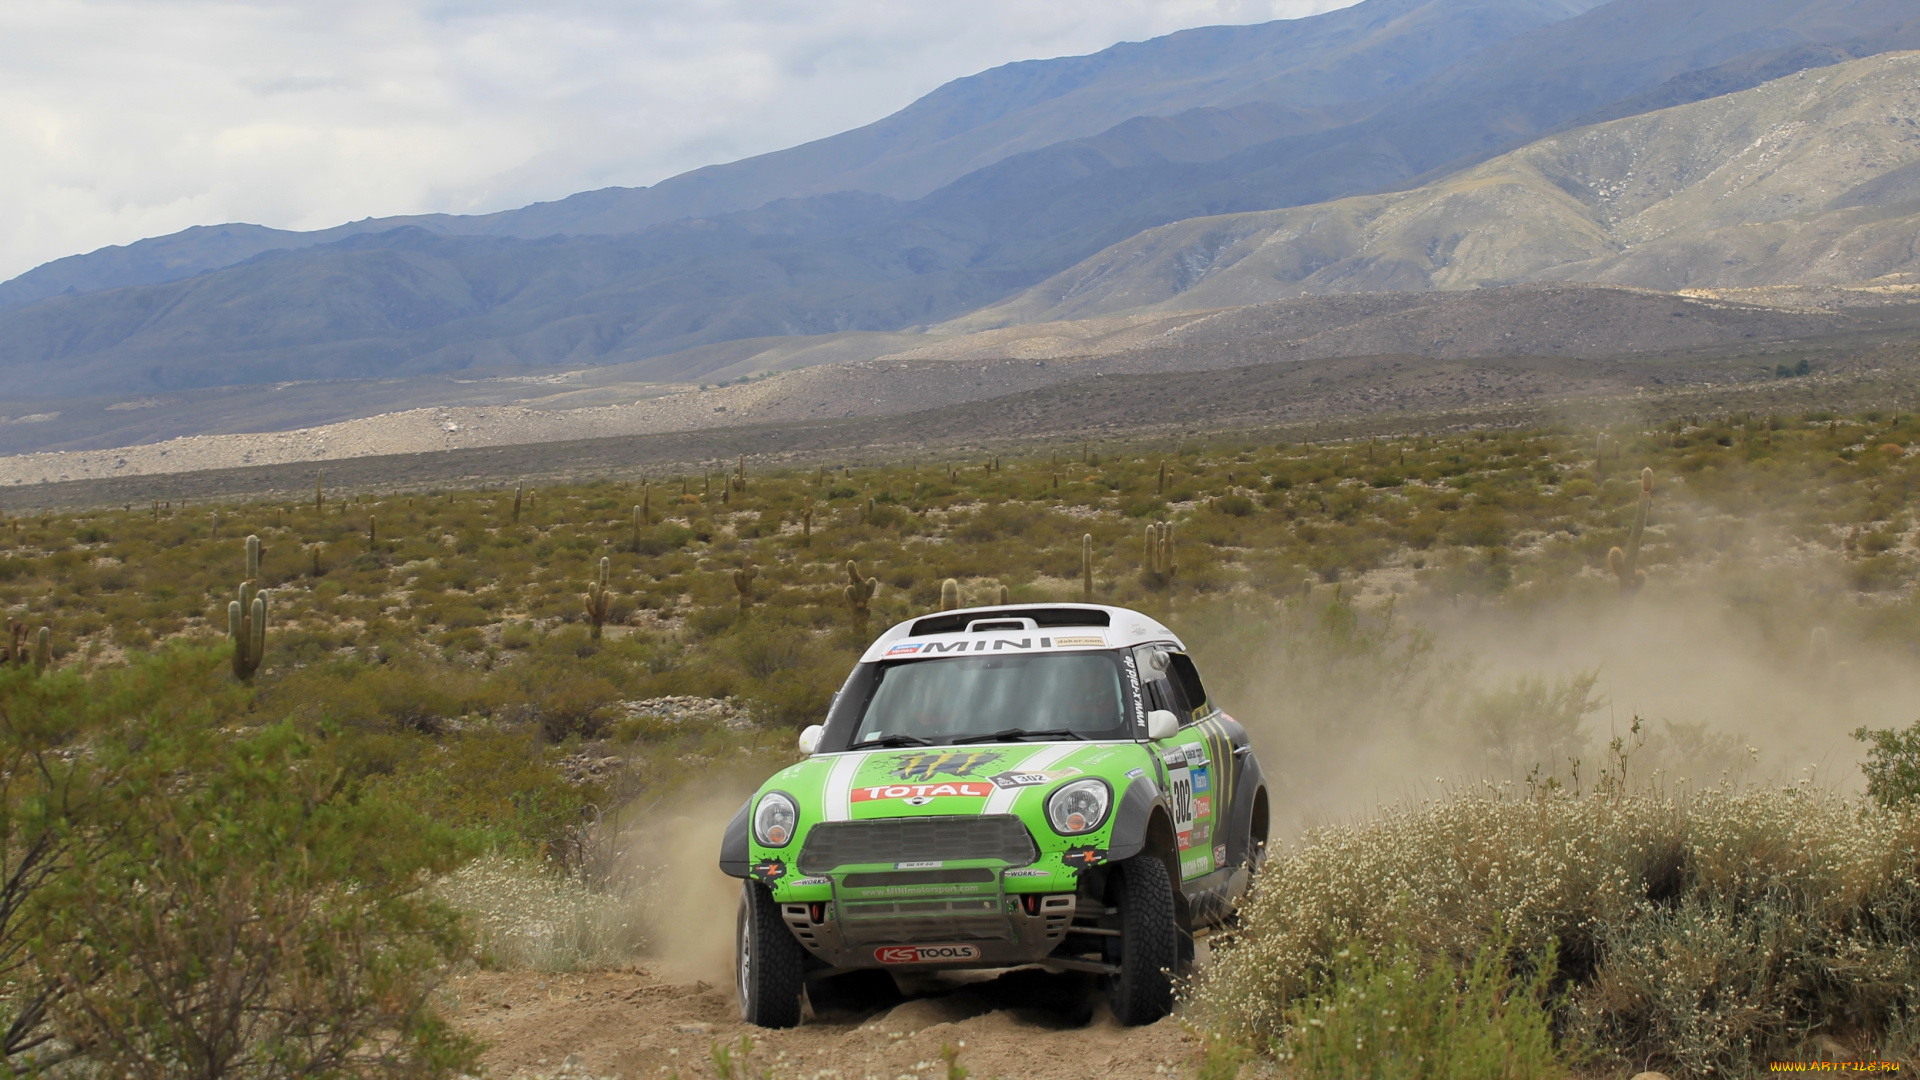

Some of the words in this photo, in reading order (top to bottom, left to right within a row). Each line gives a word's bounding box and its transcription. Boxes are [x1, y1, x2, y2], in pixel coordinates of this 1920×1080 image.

[922, 637, 1051, 653] MINI
[1057, 637, 1104, 645] dakar.com
[1123, 655, 1146, 728] www.x-raid.de
[863, 784, 982, 799] TOTAL
[1173, 779, 1192, 824] 302
[861, 885, 979, 897] www.MINImotorsport.com
